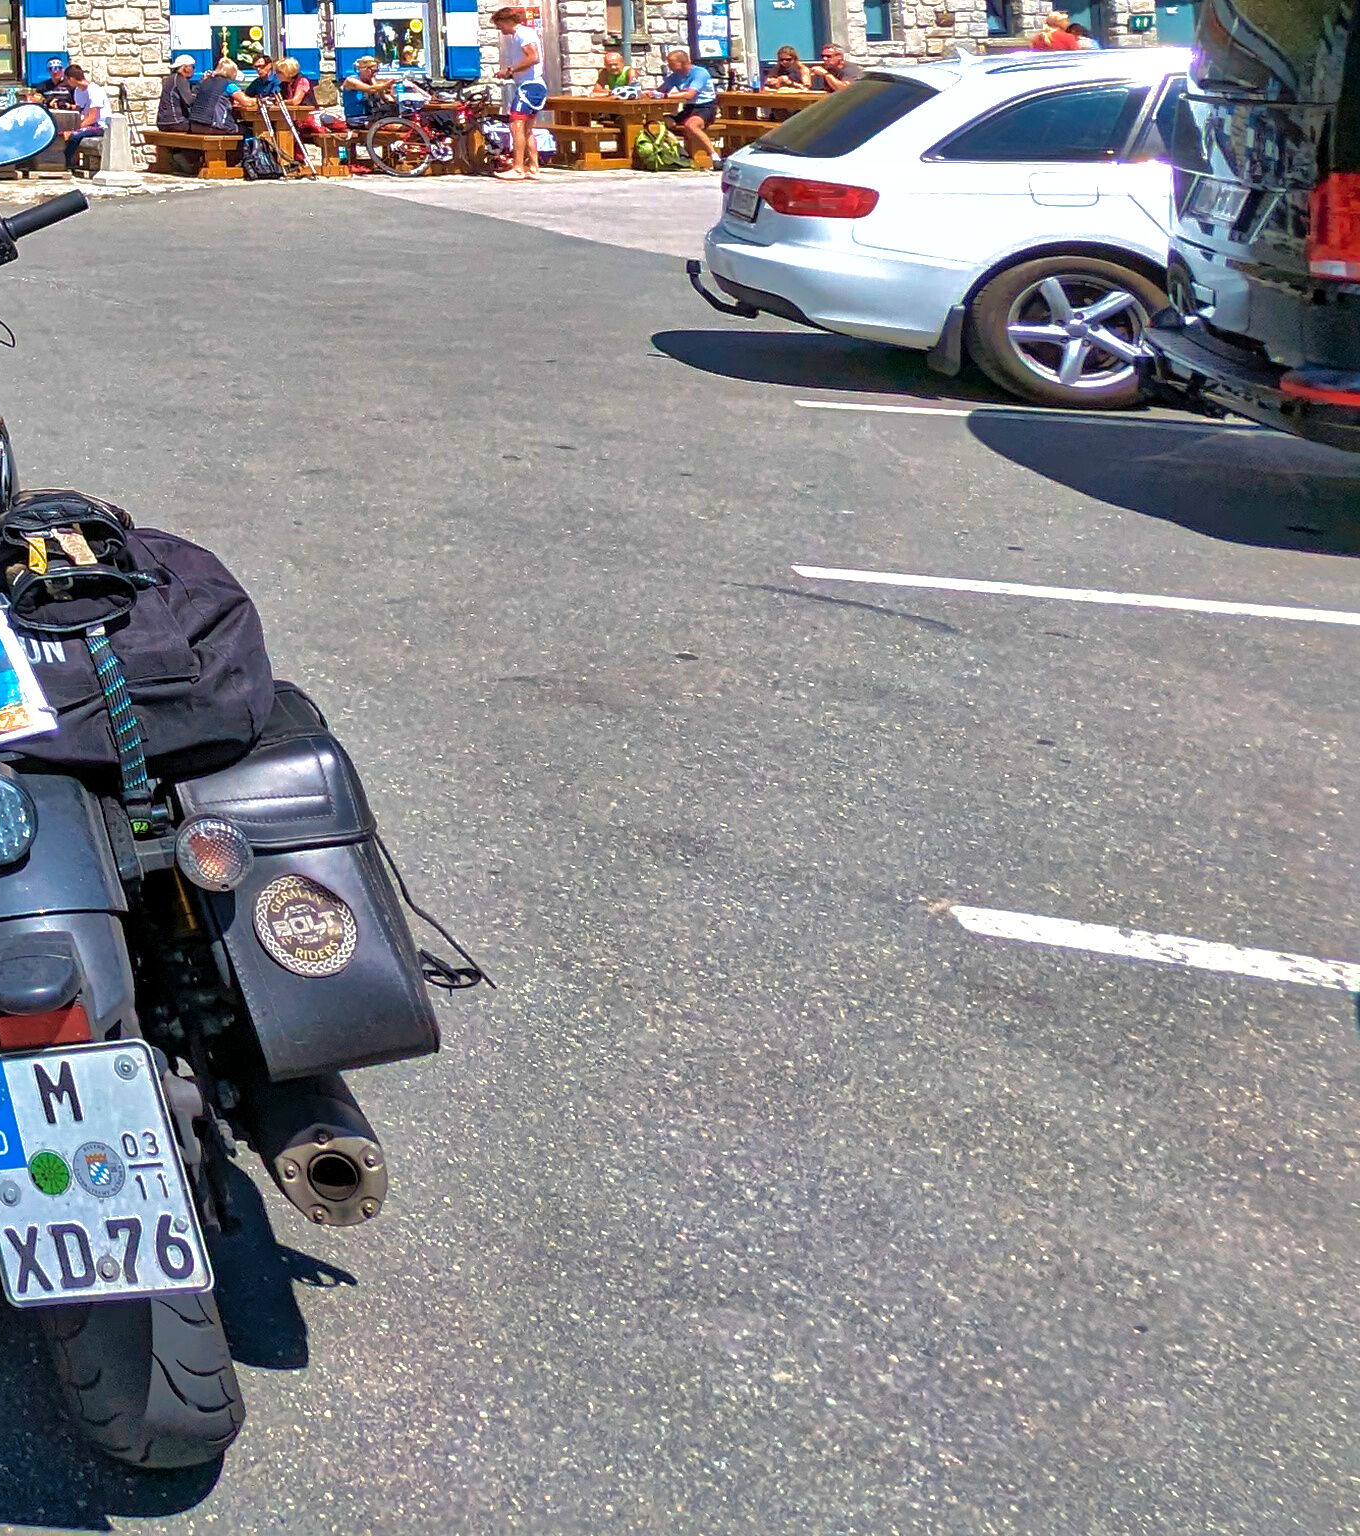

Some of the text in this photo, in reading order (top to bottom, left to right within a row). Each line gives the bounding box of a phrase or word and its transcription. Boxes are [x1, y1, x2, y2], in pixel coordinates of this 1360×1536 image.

[272, 910, 336, 938] BOLT
[294, 939, 340, 961] RIDERS
[33, 1060, 84, 1124] M
[120, 1130, 160, 1158] 03
[134, 1172, 171, 1201] 11
